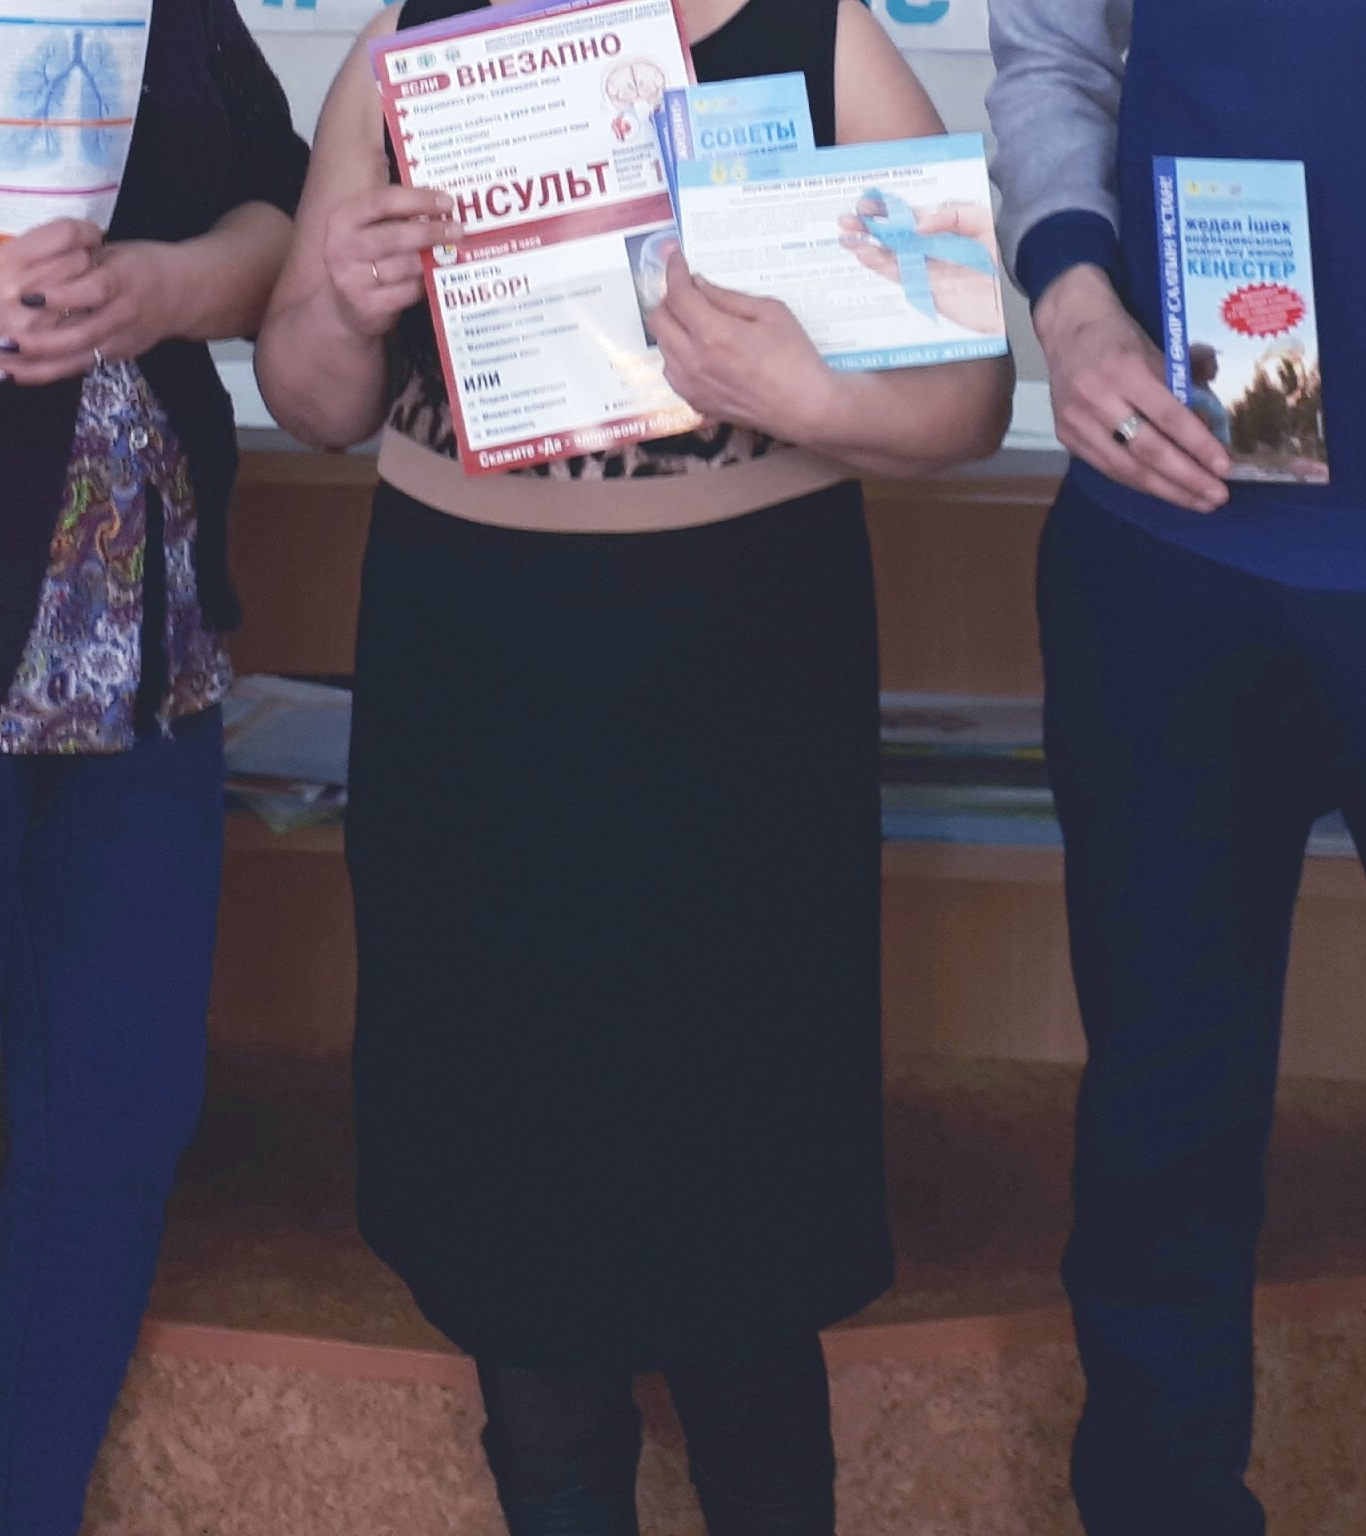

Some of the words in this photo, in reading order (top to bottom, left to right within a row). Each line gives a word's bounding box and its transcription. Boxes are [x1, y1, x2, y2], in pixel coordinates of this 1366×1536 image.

[400, 76, 439, 96] ЕСЛИ
[457, 32, 622, 88] ВНЕЗАПНО
[700, 119, 797, 148] СОВЕТЫ
[457, 161, 611, 224] НСУЛЬТ
[1187, 259, 1296, 281] КЕҢЕСТЕР
[442, 273, 531, 310] ВЫБОР!
[462, 370, 502, 394] ИЛИ
